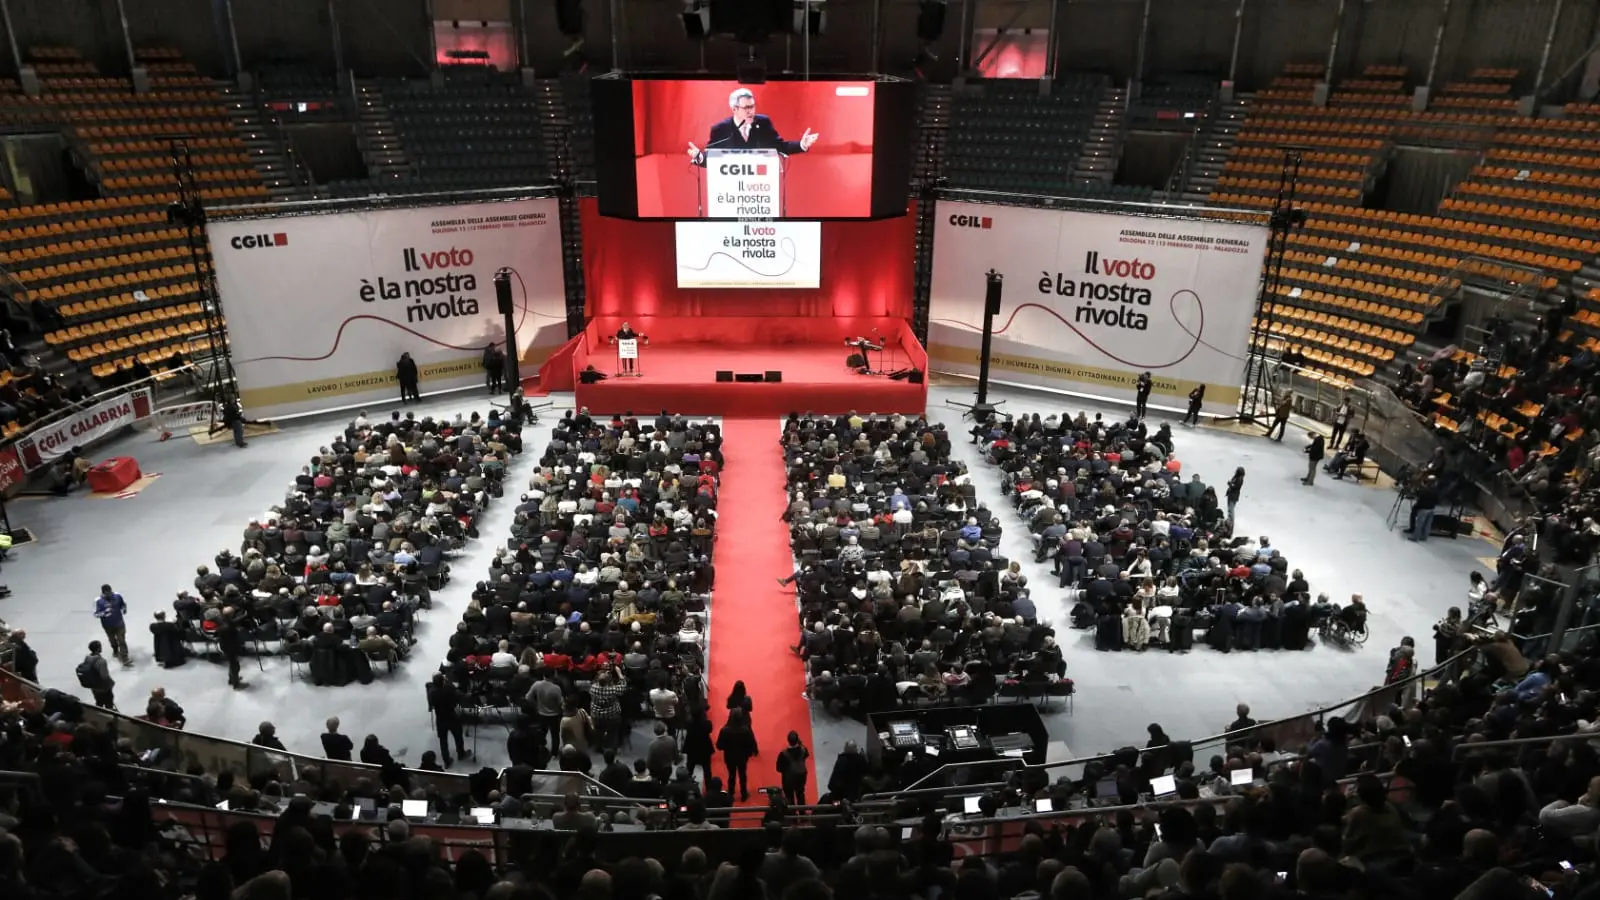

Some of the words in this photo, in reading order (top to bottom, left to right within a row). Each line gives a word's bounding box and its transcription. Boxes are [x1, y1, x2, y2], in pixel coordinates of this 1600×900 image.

[720, 164, 754, 175] CGIL
[738, 181, 744, 191] Il
[746, 182, 770, 192] voto
[718, 193, 724, 203] è
[726, 193, 735, 203] la
[738, 194, 770, 203] nostra
[737, 204, 770, 214] rivolta
[431, 219, 466, 227] ASSEMBLEA
[949, 214, 980, 228] CGIL
[744, 225, 750, 236] Il
[752, 227, 776, 236] voto
[1120, 230, 1156, 238] ASSEMBLEA
[1178, 235, 1214, 244] ASSEMBLEE
[1216, 238, 1249, 246] GENERALI
[231, 234, 274, 249] CGIL
[723, 236, 730, 247] è
[732, 236, 740, 247] la
[742, 238, 776, 247] nostra
[403, 248, 420, 272] Il
[421, 246, 474, 270] voto
[742, 248, 776, 258] rivolta
[1084, 251, 1099, 274] Il
[1102, 257, 1156, 280] voto
[360, 279, 376, 302] è
[378, 277, 401, 300] la
[405, 273, 476, 298] nostra
[1038, 271, 1052, 294] è
[1056, 273, 1075, 297] la
[1080, 282, 1152, 306] nostra
[407, 295, 479, 322] rivolta
[1075, 302, 1148, 330] rivolta
[308, 384, 337, 394] LAVORO
[345, 378, 384, 388] SICUREZZA
[424, 365, 472, 376] CITTADINANZA
[1006, 360, 1039, 370] SICUREZZA
[1046, 366, 1071, 375] DIGNITÀ
[1077, 370, 1125, 384] CITTADINANZA
[38, 429, 68, 452] CGIL
[70, 402, 130, 437] CALABRIA
